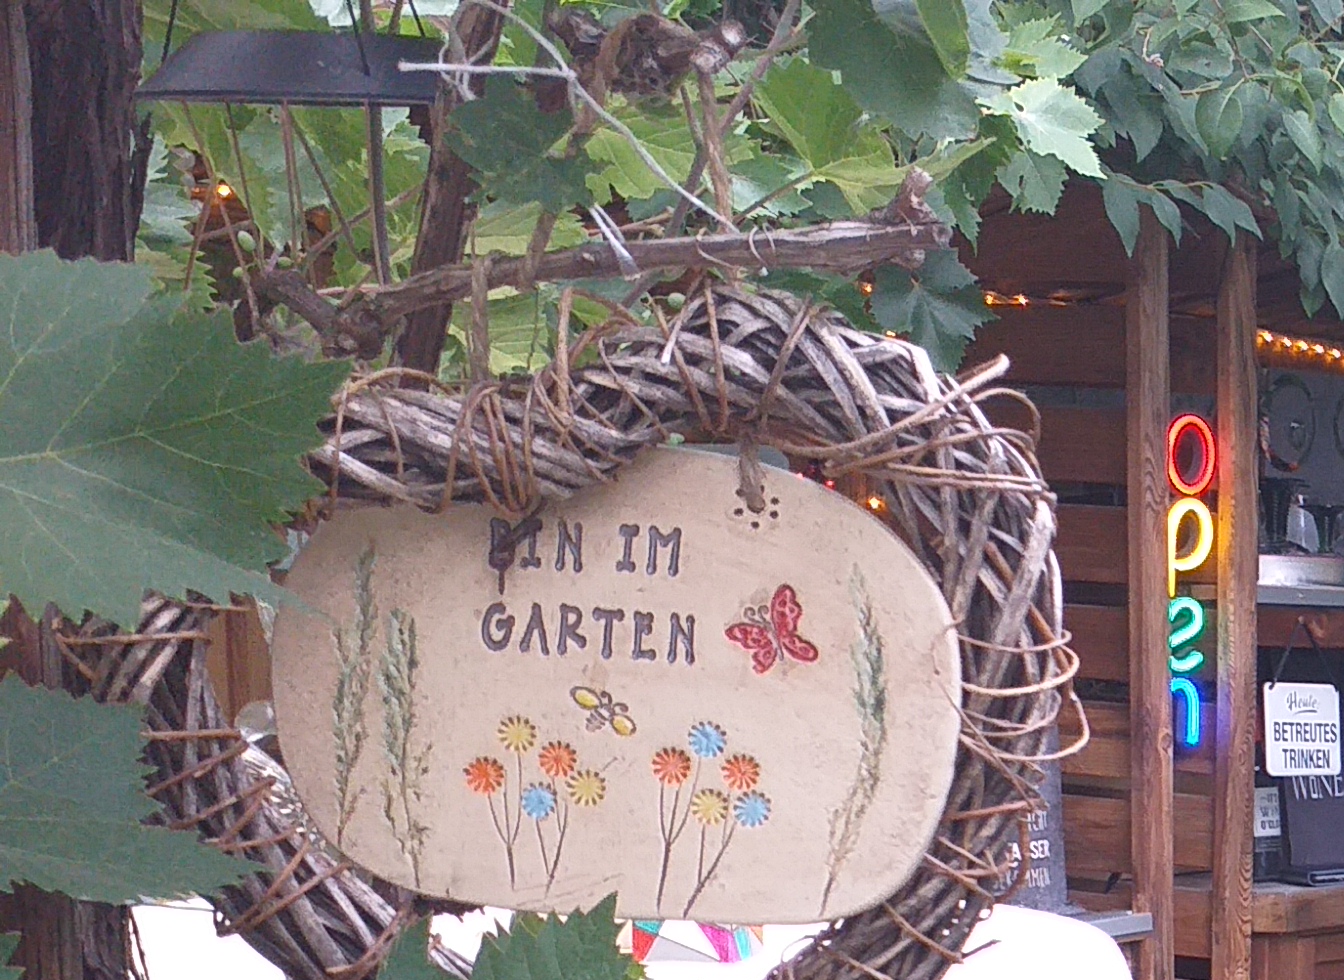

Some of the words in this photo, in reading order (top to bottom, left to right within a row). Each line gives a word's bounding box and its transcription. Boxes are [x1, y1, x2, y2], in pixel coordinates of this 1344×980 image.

[489, 517, 583, 573] BIN
[616, 523, 683, 577] IM
[481, 602, 696, 665] GARTEN
[1273, 721, 1338, 743] BETREUTES
[1282, 748, 1331, 769] TRINKEN
[1006, 839, 1051, 861] ASER
